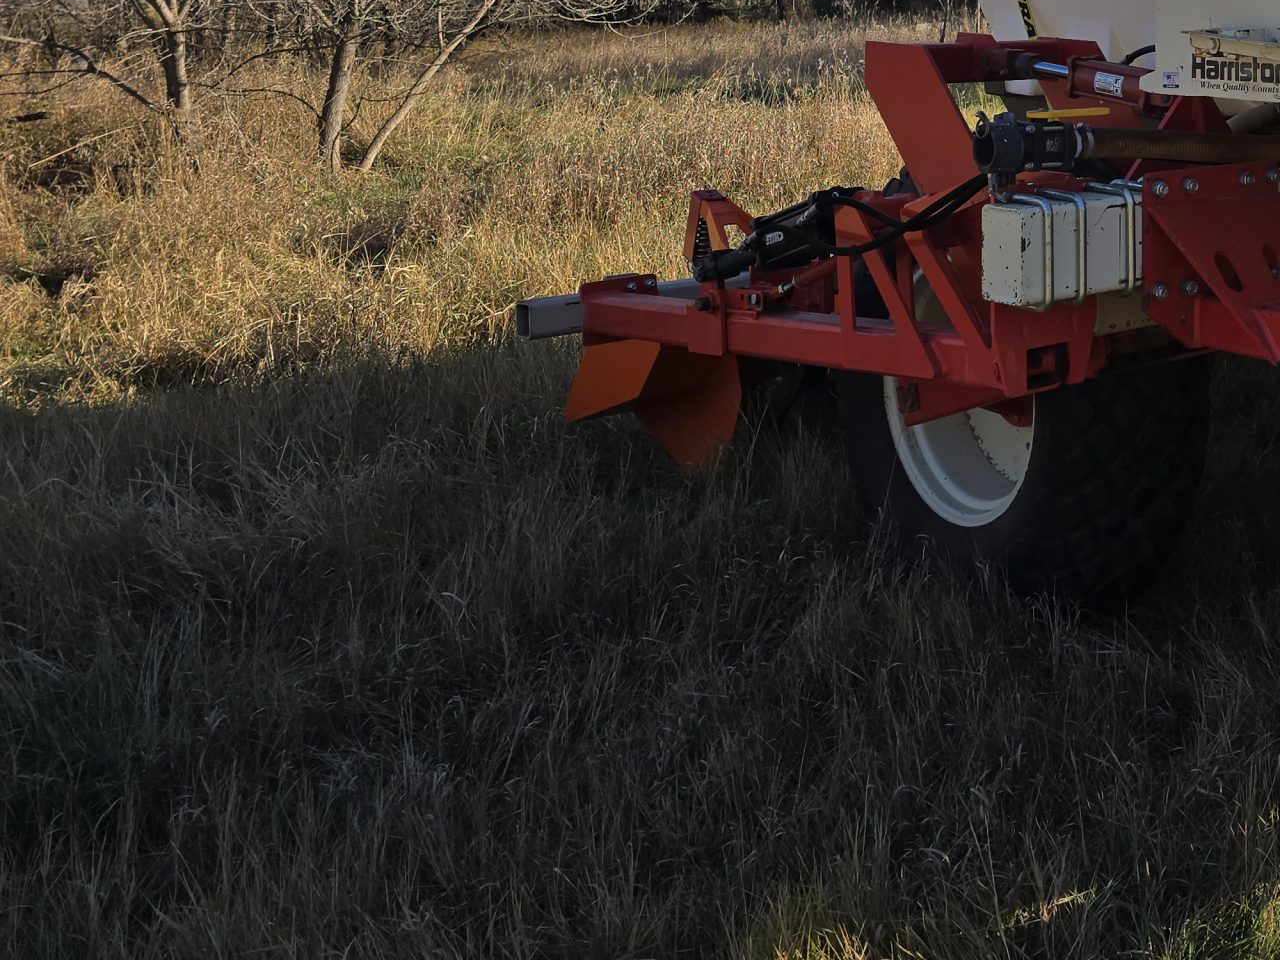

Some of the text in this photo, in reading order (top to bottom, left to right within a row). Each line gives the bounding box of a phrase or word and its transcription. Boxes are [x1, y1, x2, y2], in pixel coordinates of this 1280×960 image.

[1200, 80, 1280, 94] When Quality Counts
